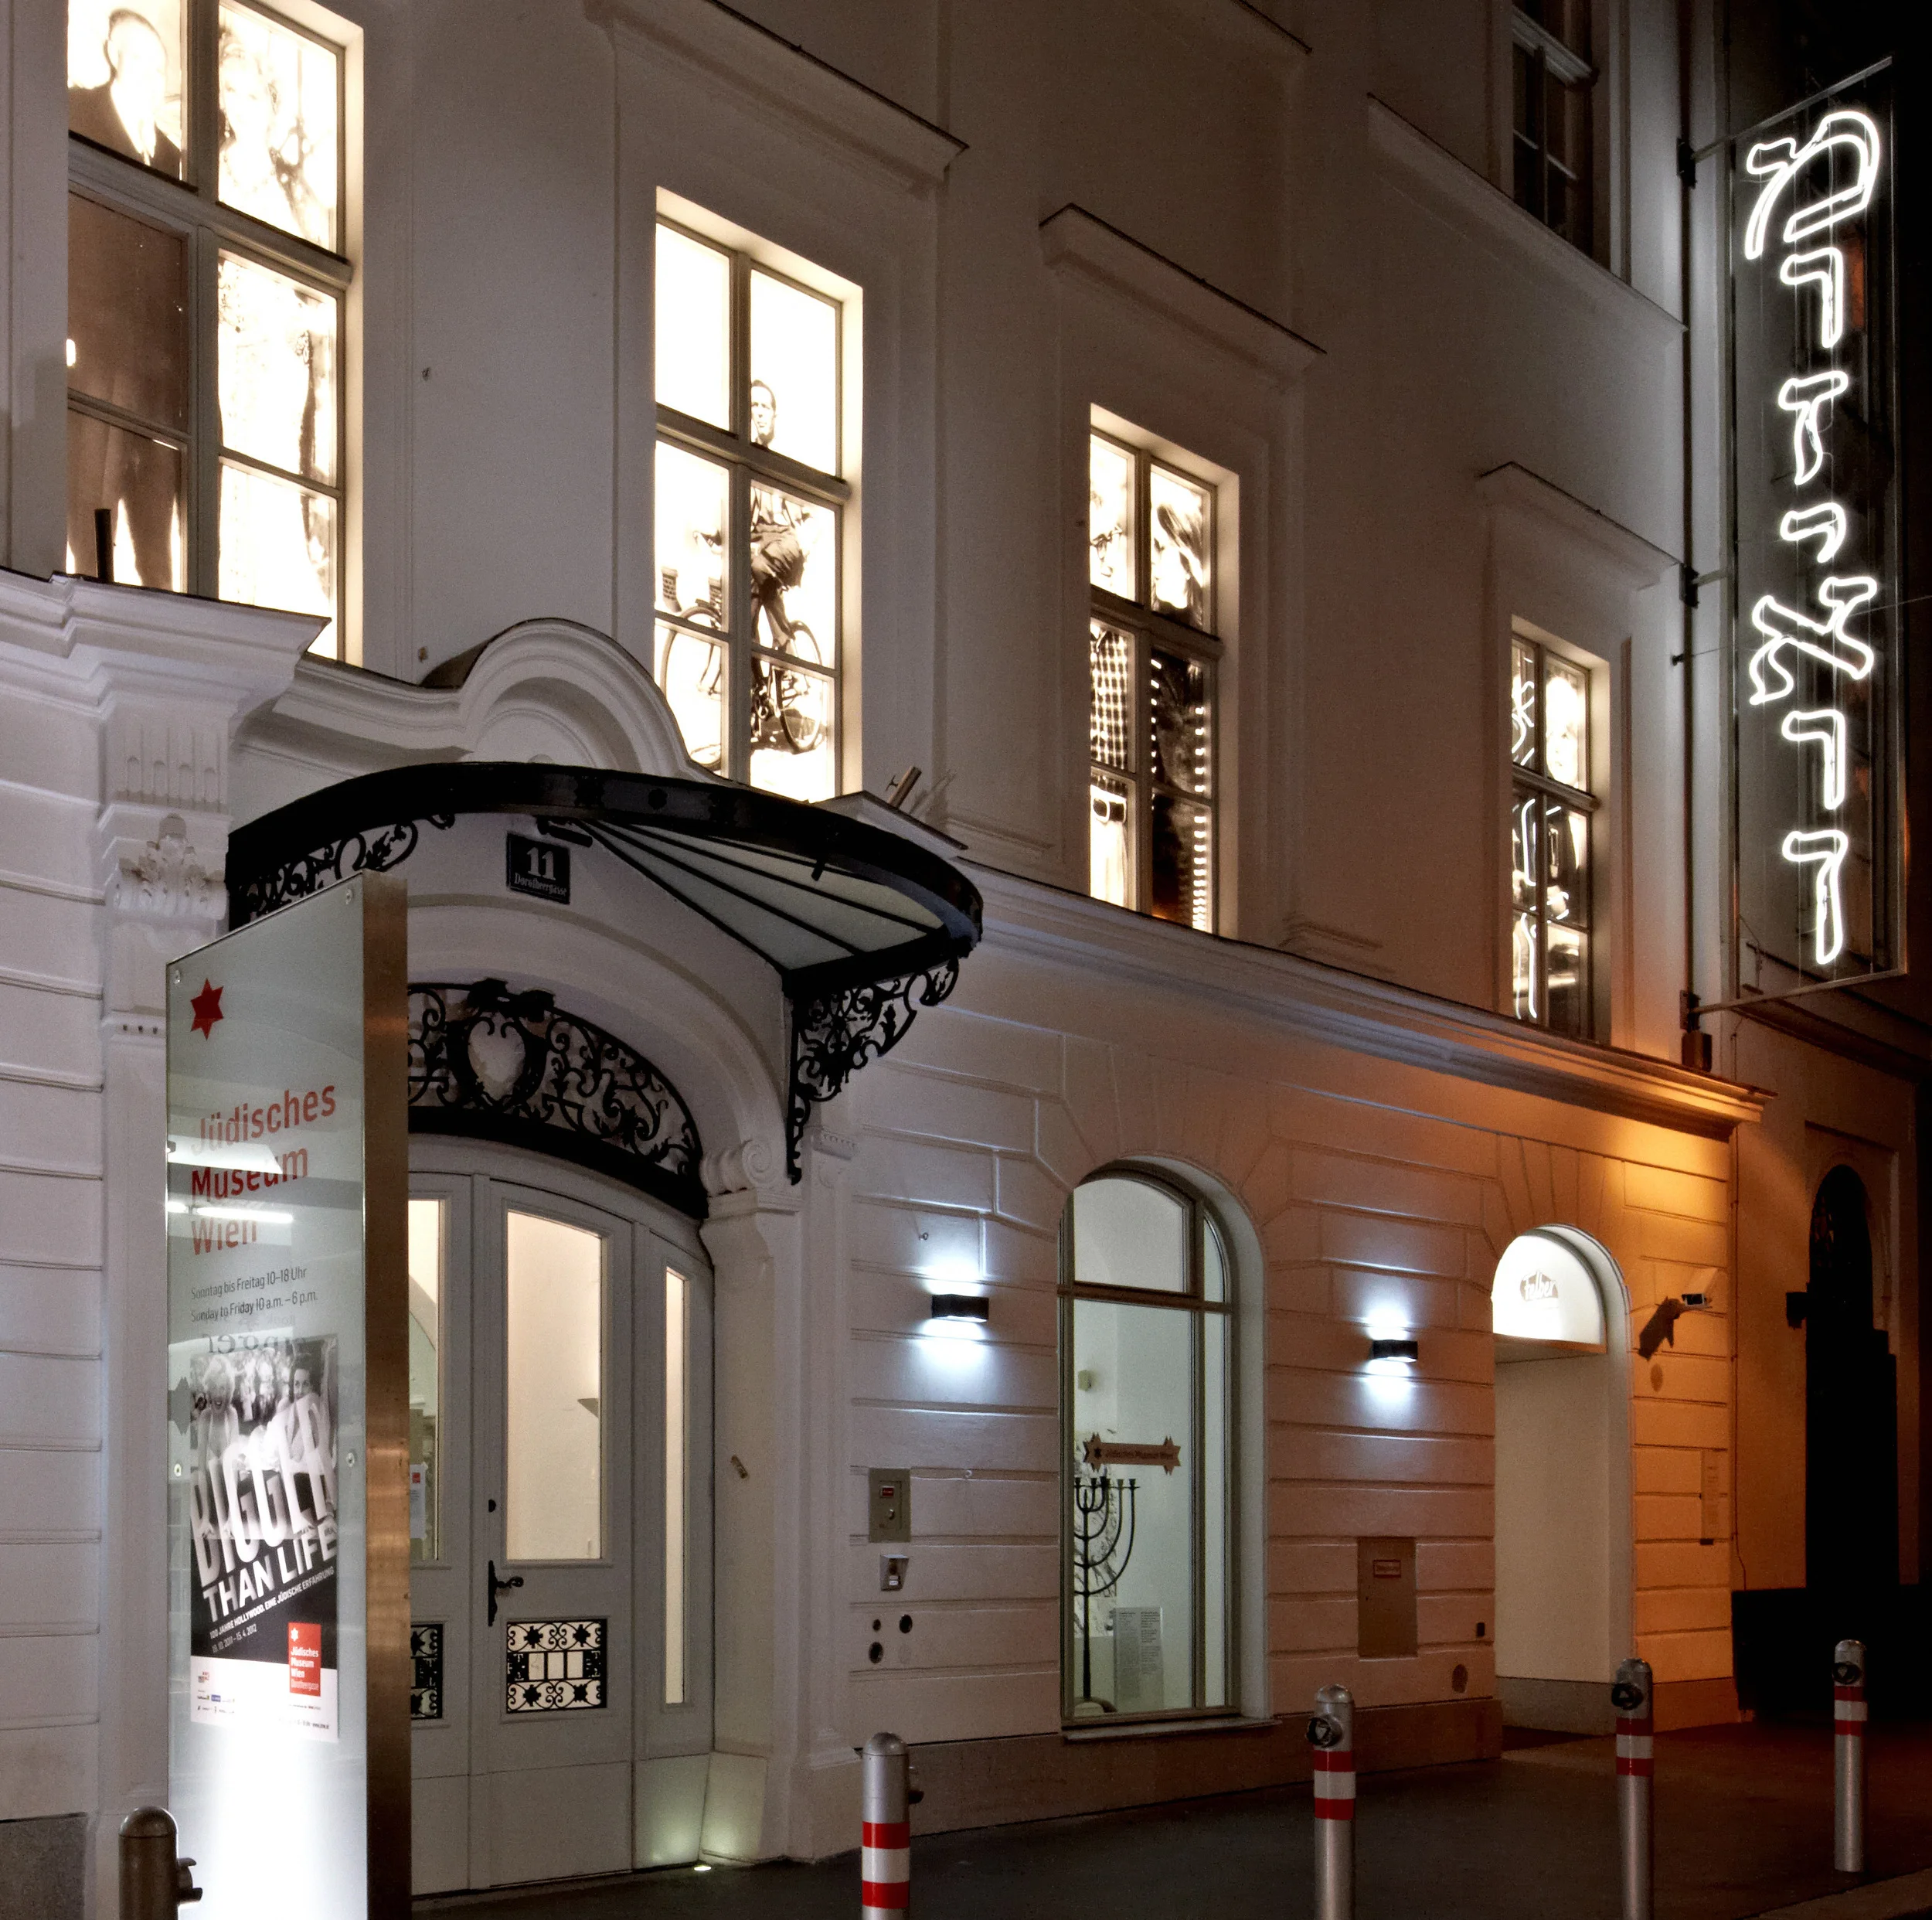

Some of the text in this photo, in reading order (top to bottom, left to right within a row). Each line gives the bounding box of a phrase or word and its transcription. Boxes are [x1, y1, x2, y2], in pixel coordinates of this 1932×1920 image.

[1743, 111, 1880, 965] מוזיאון
[526, 847, 556, 880] 11
[191, 1084, 336, 1154] Jüdisches
[192, 1148, 308, 1202] Museum
[192, 1217, 257, 1255] Wien
[191, 1283, 223, 1300] Sonntag
[224, 1282, 235, 1293] bis
[236, 1278, 265, 1291] Freitag
[291, 1266, 308, 1281] Uhr
[191, 1307, 218, 1323] Sunday
[220, 1306, 229, 1318] to
[230, 1302, 254, 1316] Friday
[256, 1297, 264, 1311] 10
[266, 1297, 283, 1309] a.m.
[292, 1291, 298, 1305] 6
[300, 1290, 318, 1306] p.m.
[202, 1520, 337, 1622] THAN LIFE
[219, 1620, 234, 1636] JAHRE
[264, 1597, 277, 1610] EINE
[277, 1583, 303, 1604] JÜDISCHE
[302, 1566, 335, 1590] ERFAHRUNG
[291, 1646, 319, 1657] Jüdisches
[291, 1656, 315, 1668] Museum
[291, 1667, 304, 1678] Wien
